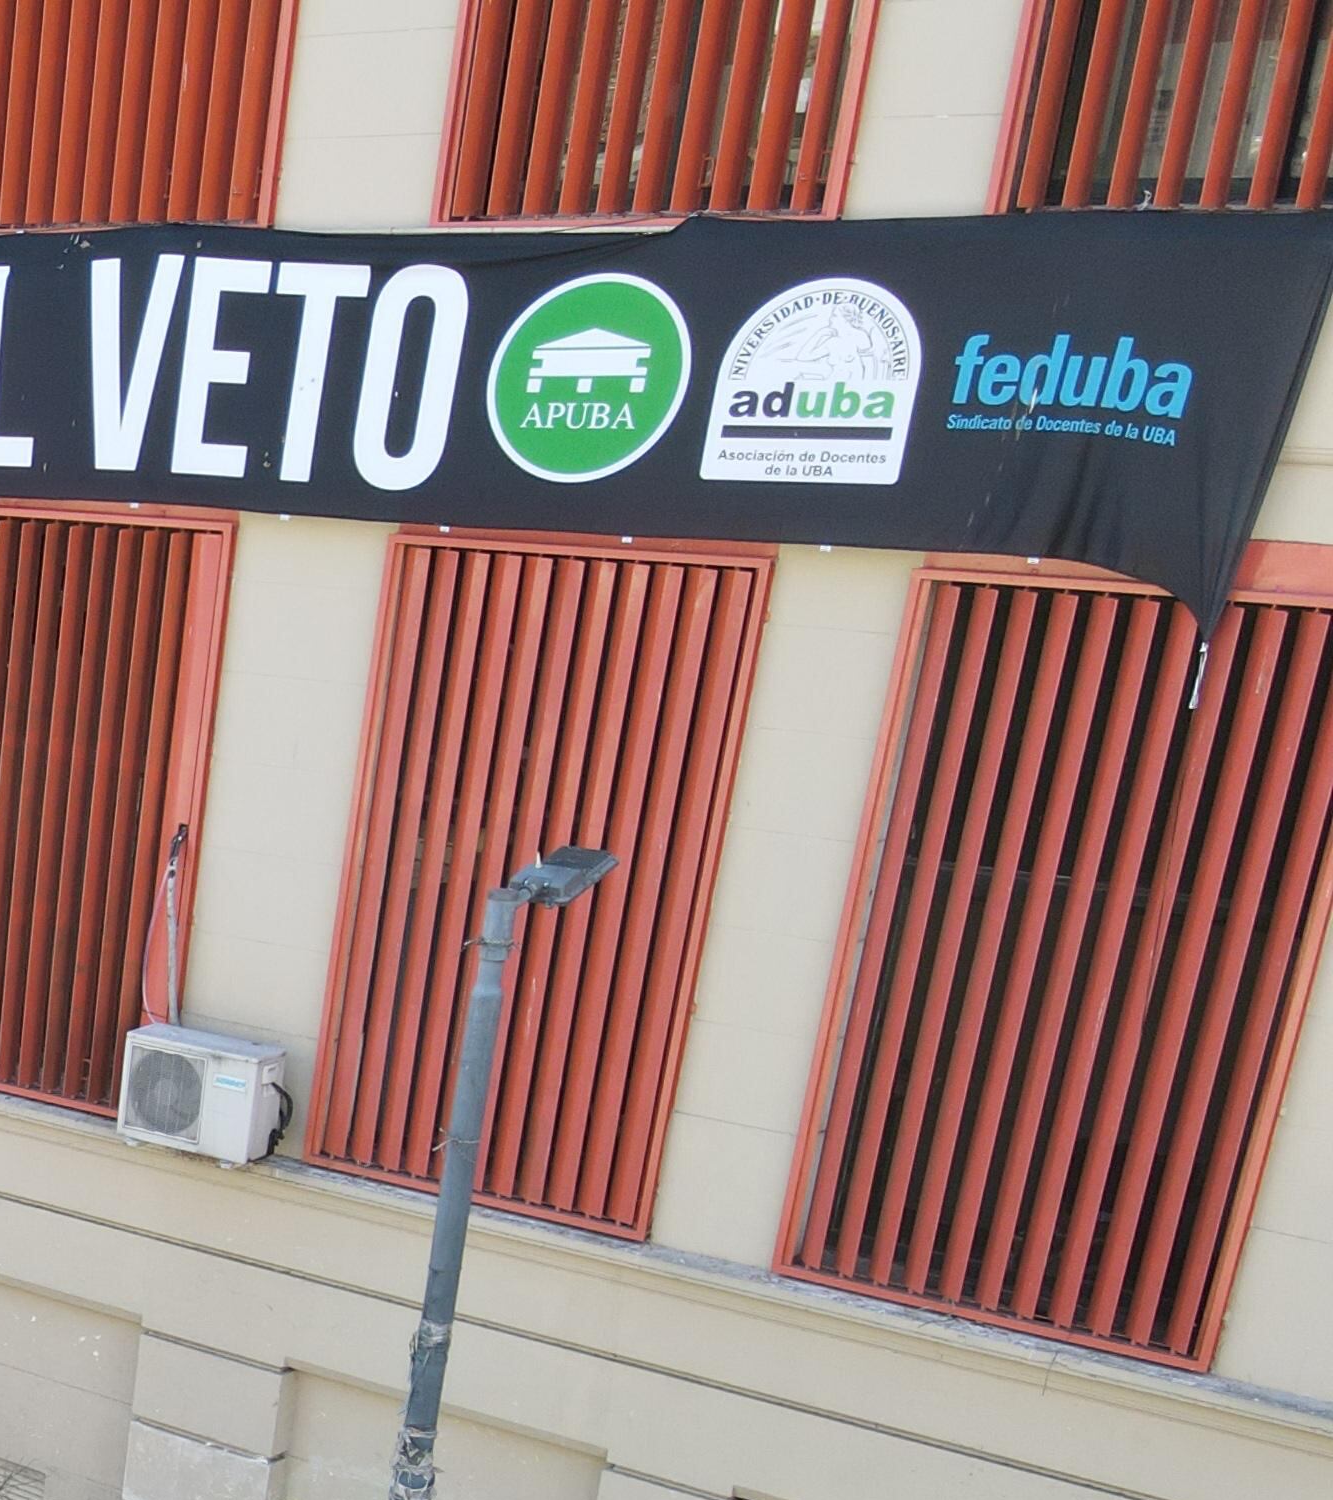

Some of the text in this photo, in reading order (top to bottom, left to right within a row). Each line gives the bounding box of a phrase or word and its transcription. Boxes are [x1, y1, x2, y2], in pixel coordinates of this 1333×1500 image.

[731, 295, 814, 379] NIVERSIDAD
[891, 340, 908, 379] AIRE
[90, 253, 469, 491] VETO
[952, 334, 1193, 419] feduba
[520, 401, 636, 430] APUBA
[728, 381, 896, 419] aduba
[946, 413, 1176, 446] Sindicato de Docentes de la UBA
[717, 449, 887, 464] Asociación de Docentes
[764, 464, 833, 477] de la UBA
